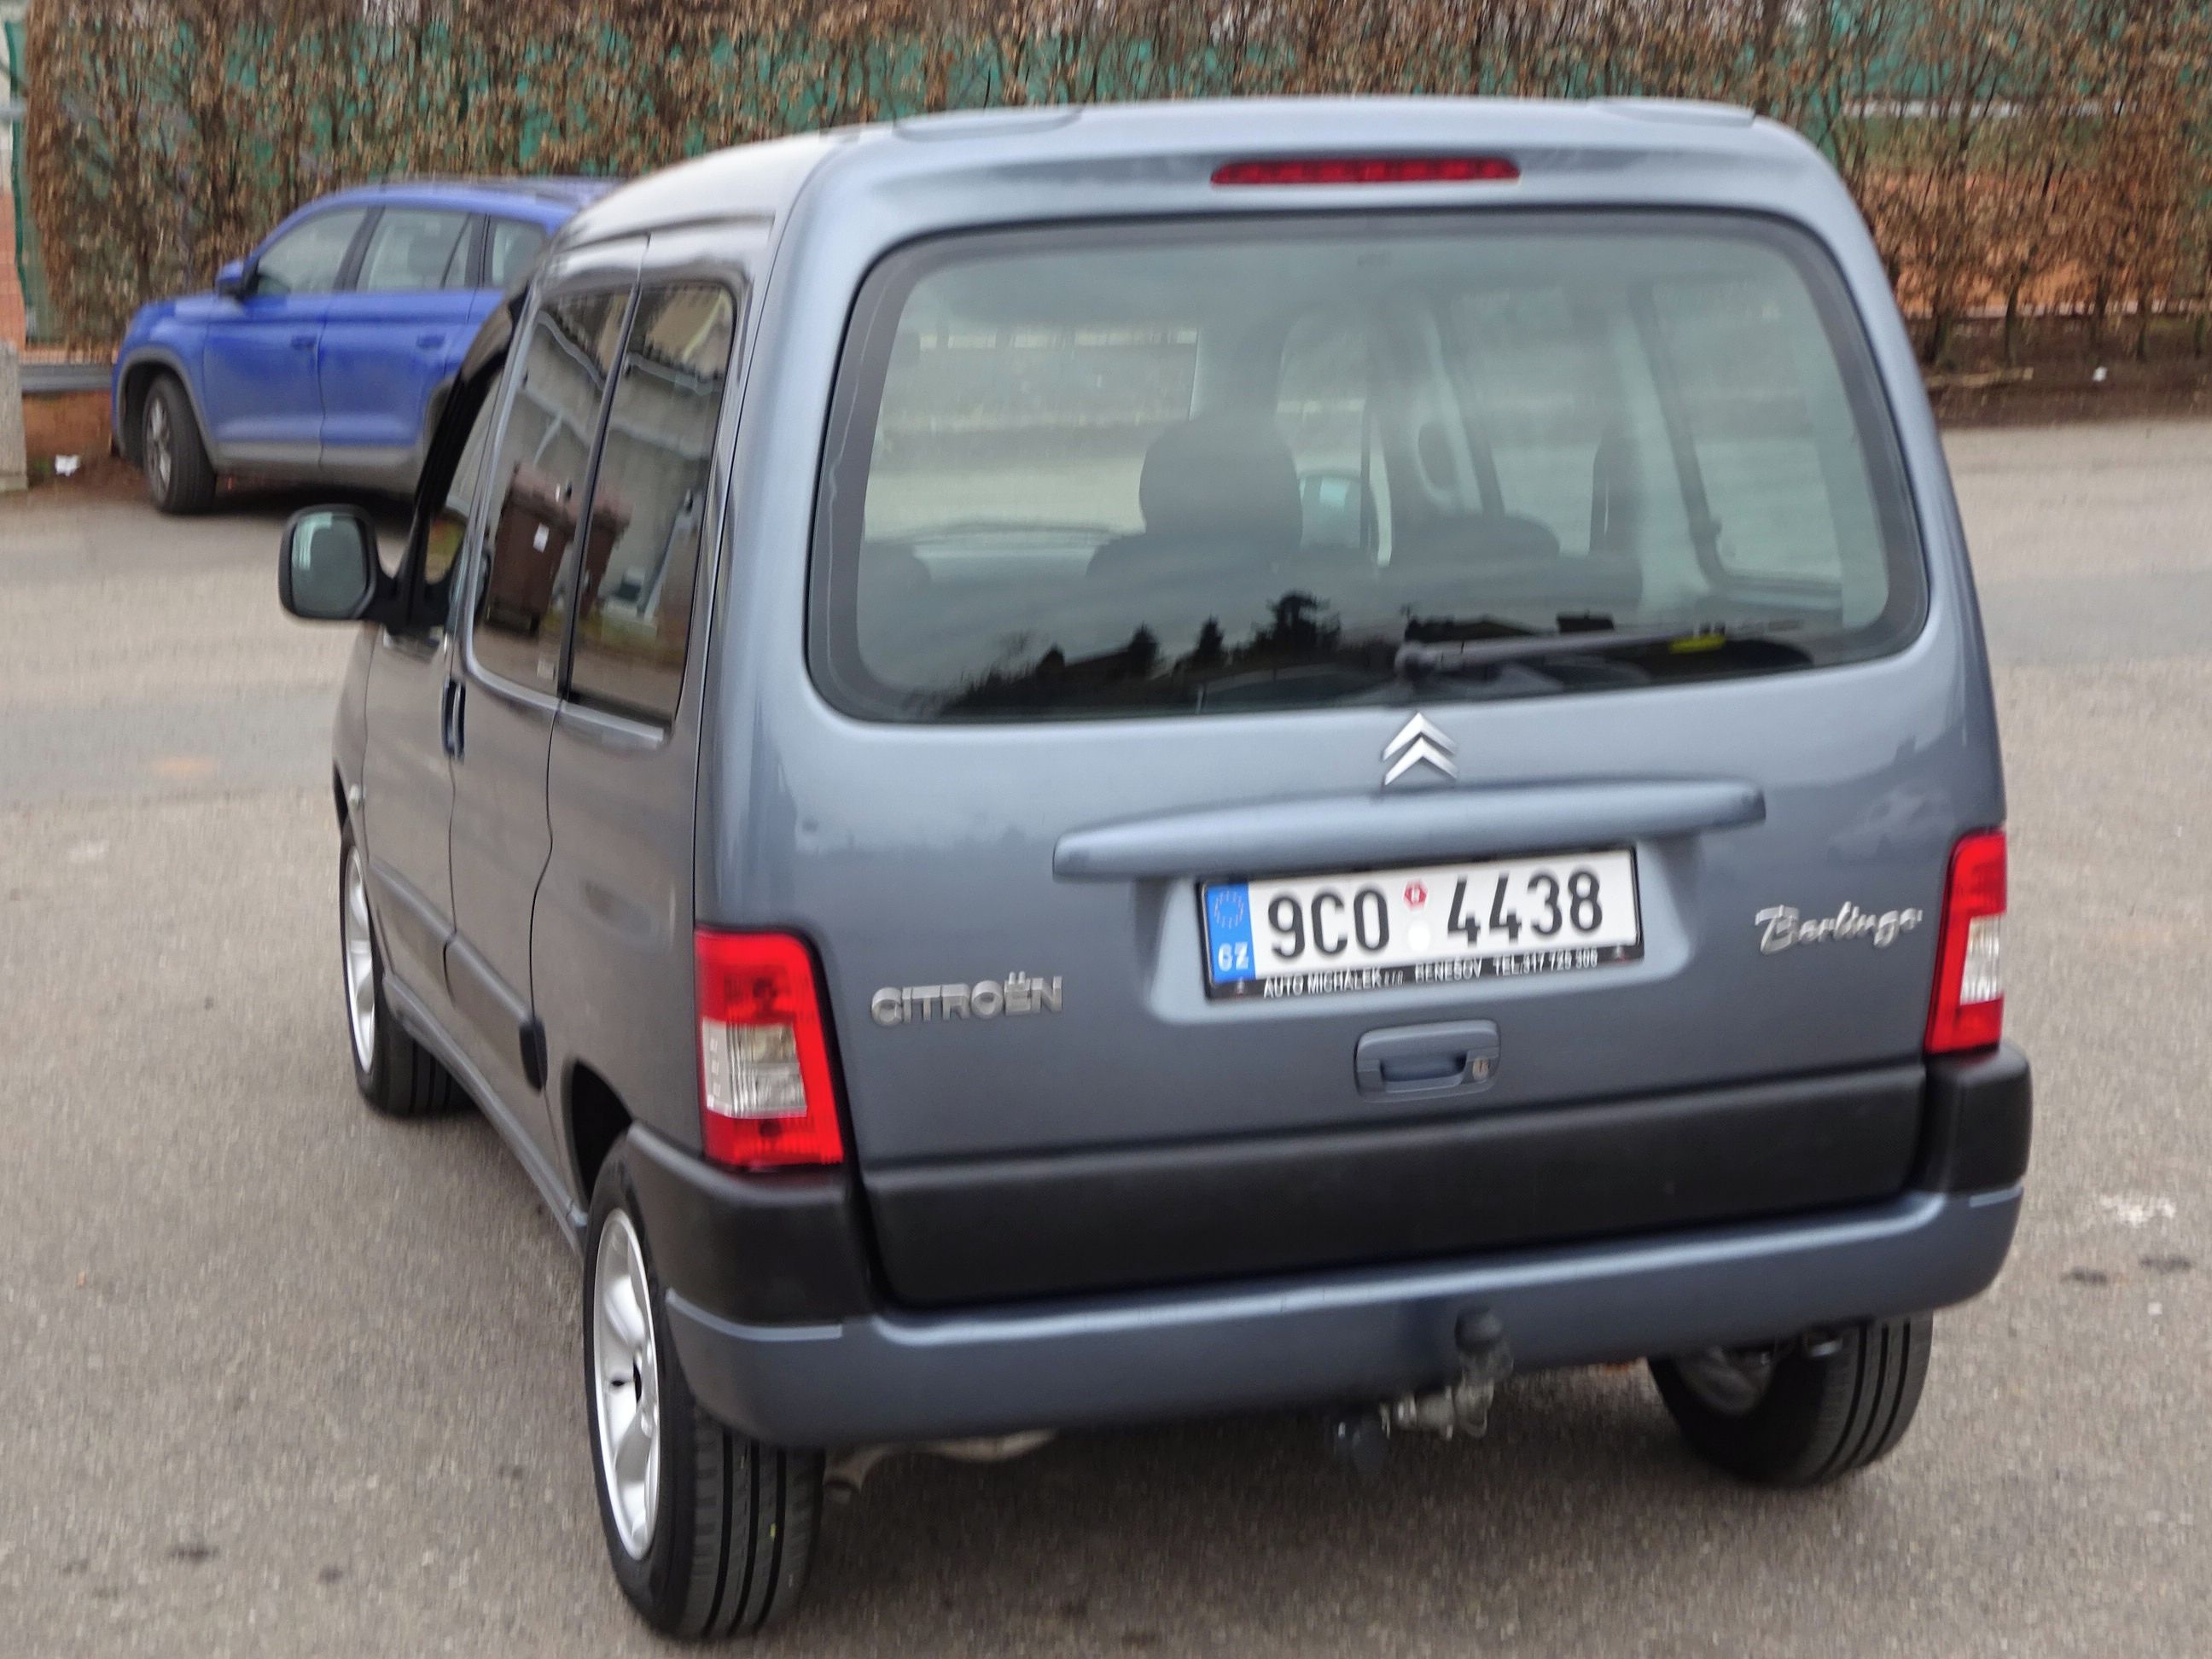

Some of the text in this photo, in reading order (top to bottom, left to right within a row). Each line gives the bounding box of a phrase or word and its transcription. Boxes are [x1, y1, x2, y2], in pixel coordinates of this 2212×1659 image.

[1266, 870, 1604, 962] 9C0 4438
[1755, 901, 1923, 955] Berlingo
[1217, 941, 1249, 971] CZ
[871, 971, 1062, 1027] CITROËN
[1263, 975, 1303, 998] AUTO
